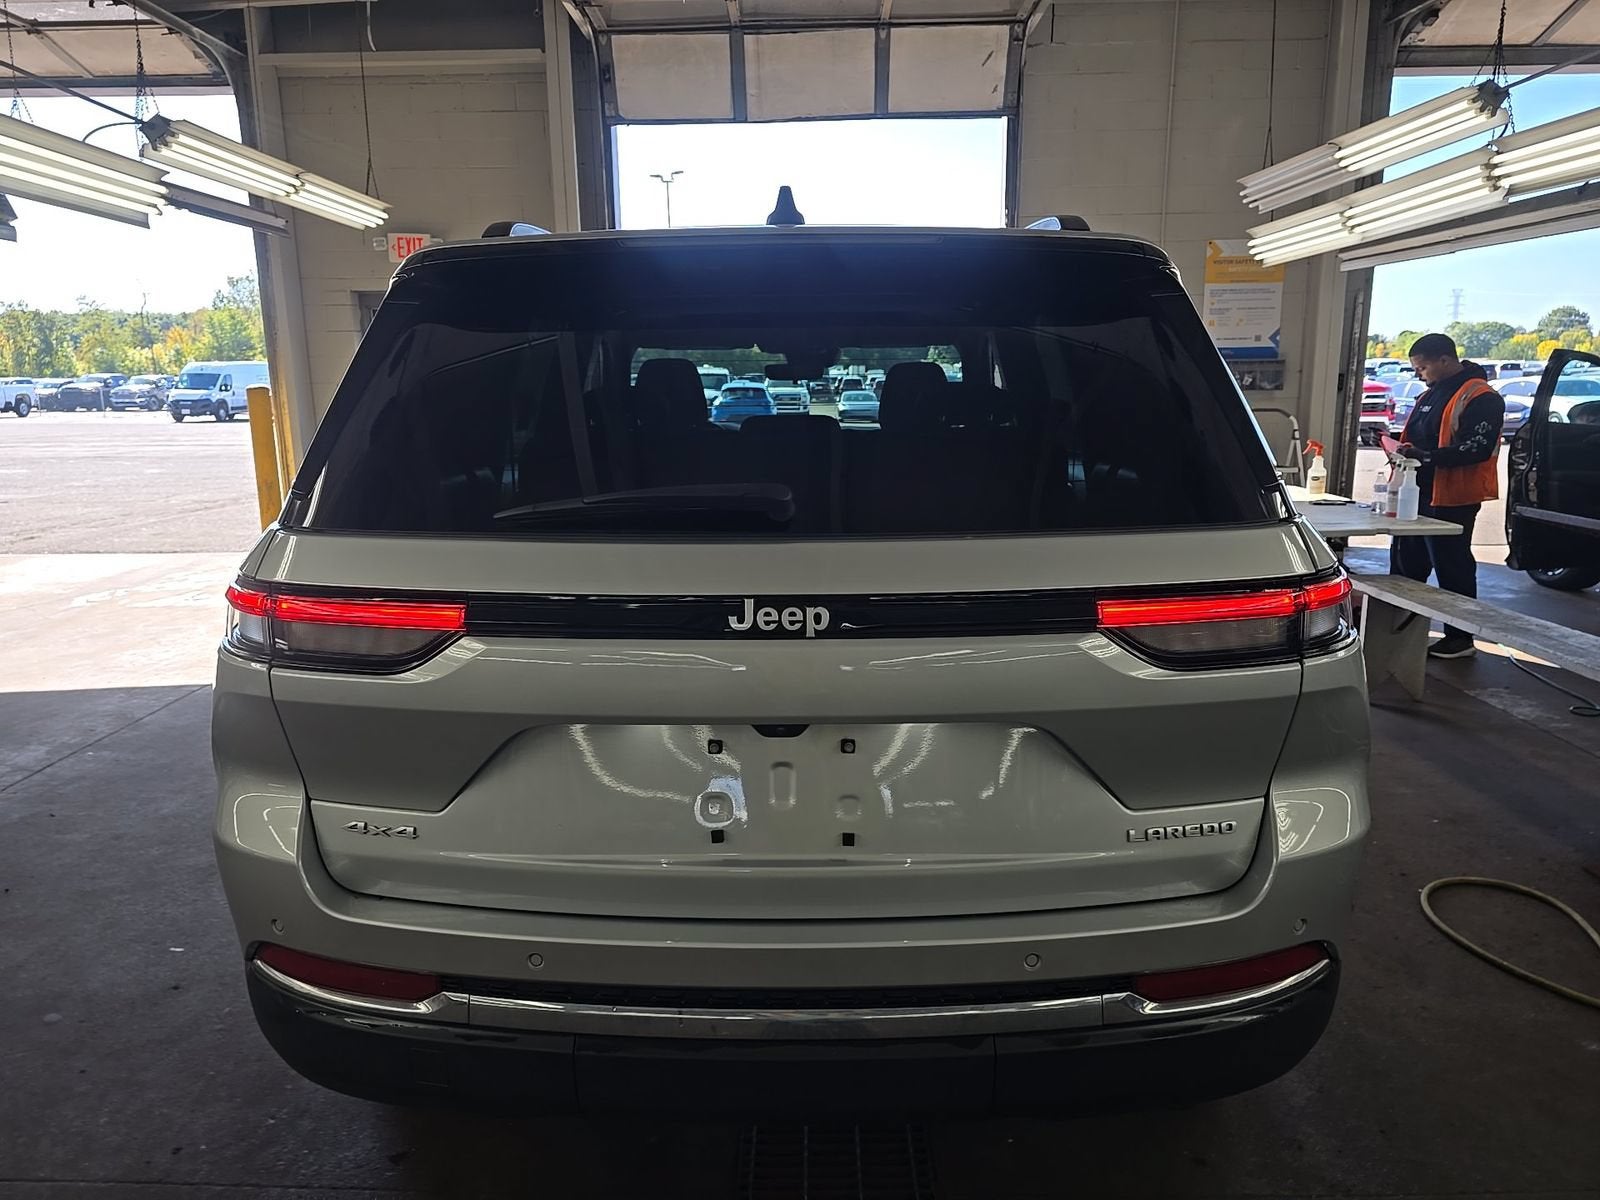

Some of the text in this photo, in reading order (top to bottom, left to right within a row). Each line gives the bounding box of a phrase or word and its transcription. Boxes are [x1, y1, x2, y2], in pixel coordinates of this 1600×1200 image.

[397, 237, 424, 258] EXIT
[728, 598, 830, 638] Jeep
[342, 820, 419, 840] 4x4
[1127, 820, 1238, 843] LAREDO
